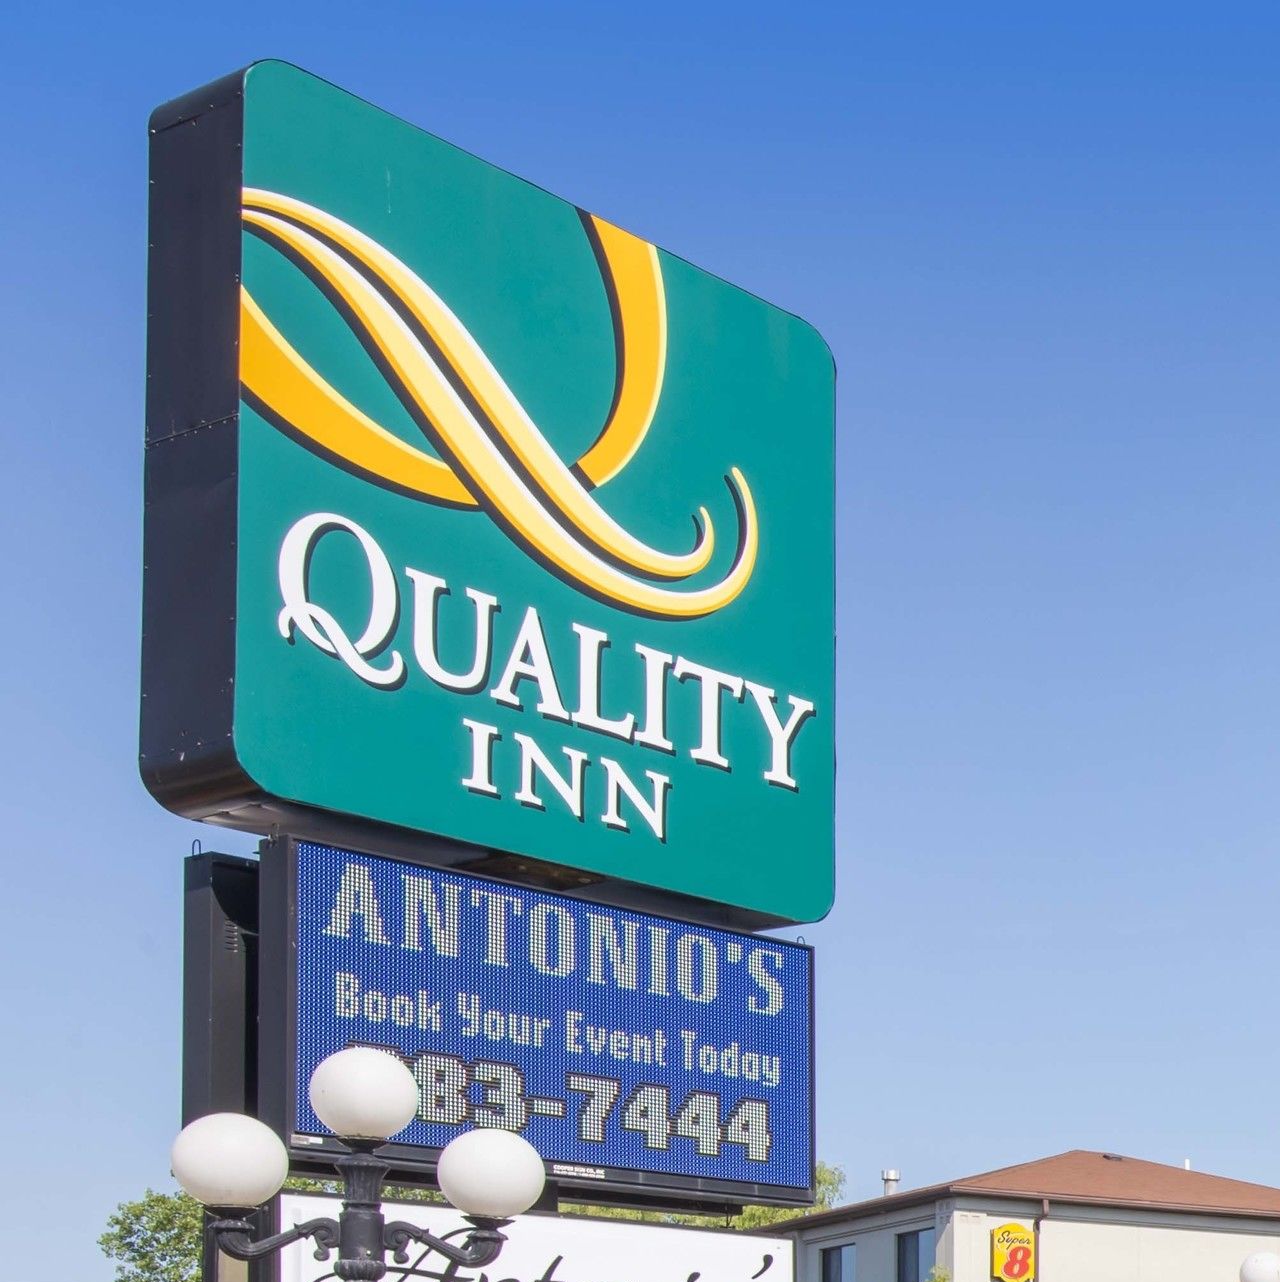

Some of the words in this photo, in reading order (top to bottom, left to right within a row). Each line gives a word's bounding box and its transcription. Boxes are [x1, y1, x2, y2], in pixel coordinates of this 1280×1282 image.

[277, 512, 815, 789] QUALITY
[461, 718, 670, 840] INN
[322, 863, 785, 1018] ANTONIO'S
[335, 971, 442, 1033] Book
[456, 991, 551, 1049] Your
[566, 1010, 667, 1068] Event
[680, 1028, 781, 1087] Today
[346, 1043, 772, 1162] 83-7444
[997, 1230, 1031, 1250] Super
[1003, 1246, 1032, 1279] 8
